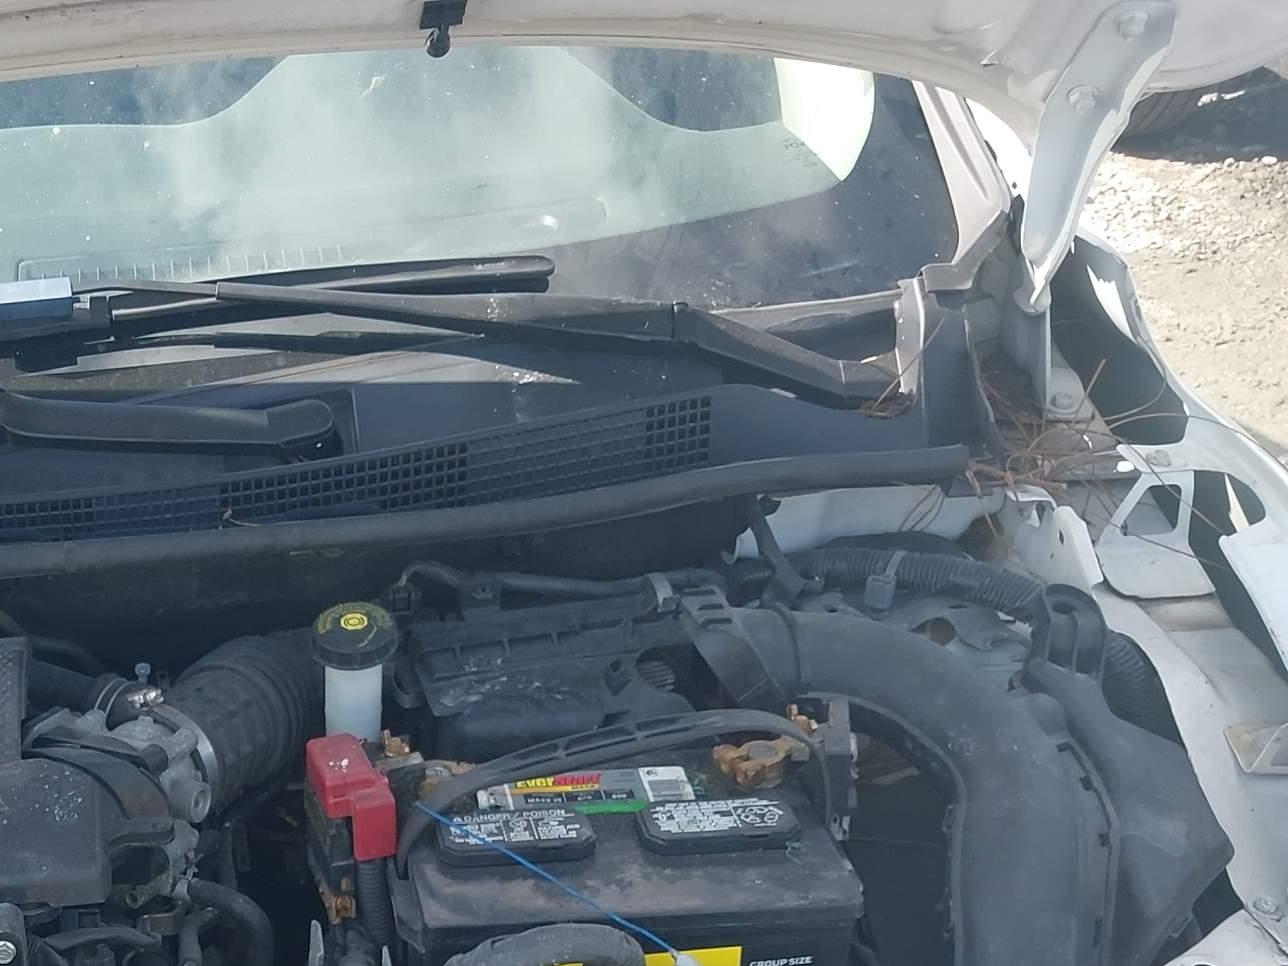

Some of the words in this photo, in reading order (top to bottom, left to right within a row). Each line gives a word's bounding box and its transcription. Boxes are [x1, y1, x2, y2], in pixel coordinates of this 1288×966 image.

[463, 813, 511, 823] DANGER
[523, 809, 565, 818] POISON
[788, 956, 813, 966] SIZE
